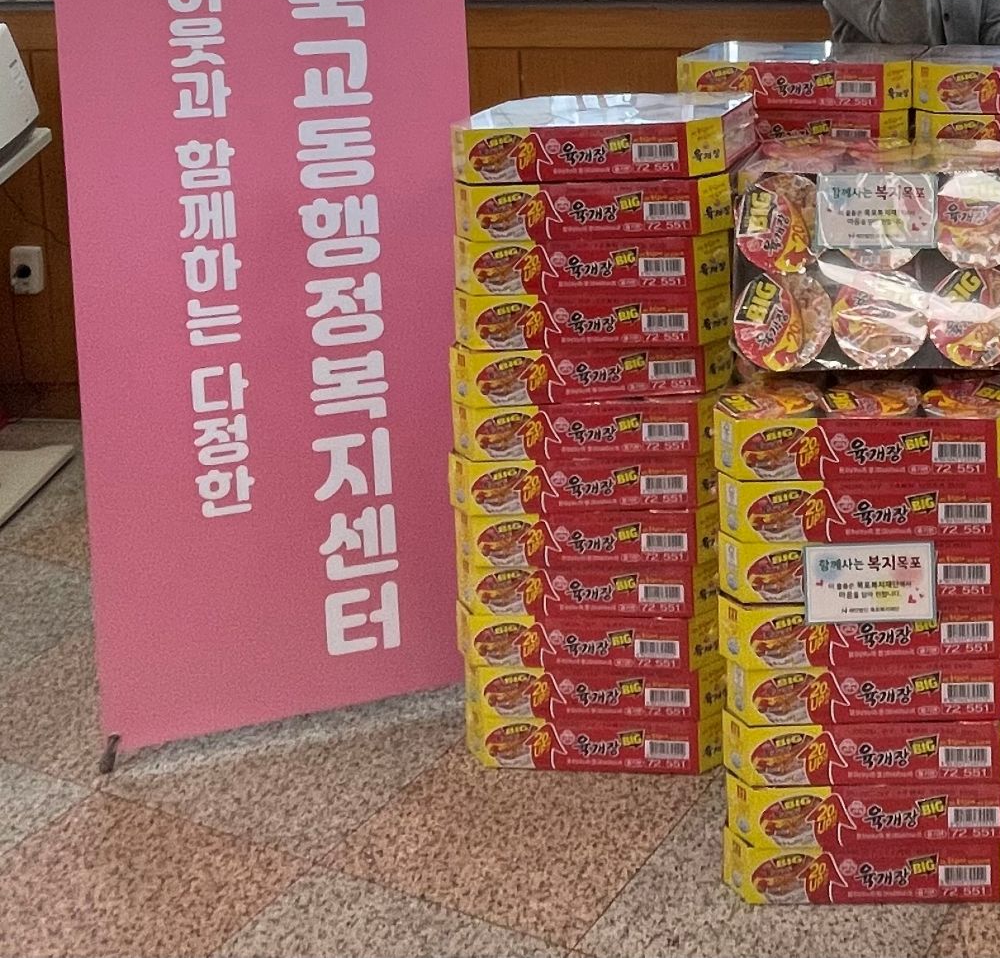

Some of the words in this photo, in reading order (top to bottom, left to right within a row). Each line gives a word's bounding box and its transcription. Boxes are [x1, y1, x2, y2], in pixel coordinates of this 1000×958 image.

[774, 77, 812, 96] 육개장
[816, 77, 834, 86] BIG
[560, 142, 606, 164] 육개장
[609, 138, 629, 150] BIG
[570, 200, 617, 223] 육개장
[620, 197, 640, 209] BIG
[175, 138, 242, 346] 함께하는
[565, 255, 612, 278] 육개장
[615, 252, 635, 264] BIG
[746, 280, 777, 322] BIG
[568, 311, 615, 334] 육개장
[618, 308, 638, 320] BIG
[191, 362, 255, 518] 다정한
[848, 439, 901, 463] 육개장
[905, 436, 929, 450] BIG
[936, 466, 951, 474] 72
[958, 464, 980, 473] 551
[855, 501, 907, 524] 육개장
[911, 498, 934, 512] BIG
[819, 558, 864, 572] 함께사는
[868, 554, 922, 571] 복지목포
[858, 623, 910, 646] 육개장
[859, 682, 911, 705] 육개장
[915, 679, 938, 693] BIG
[856, 744, 908, 767] 육개장
[912, 741, 935, 755] BIG
[866, 805, 918, 828] 육개장
[922, 802, 945, 816] BIG
[856, 864, 908, 887] 육개장
[912, 861, 935, 875] BIG
